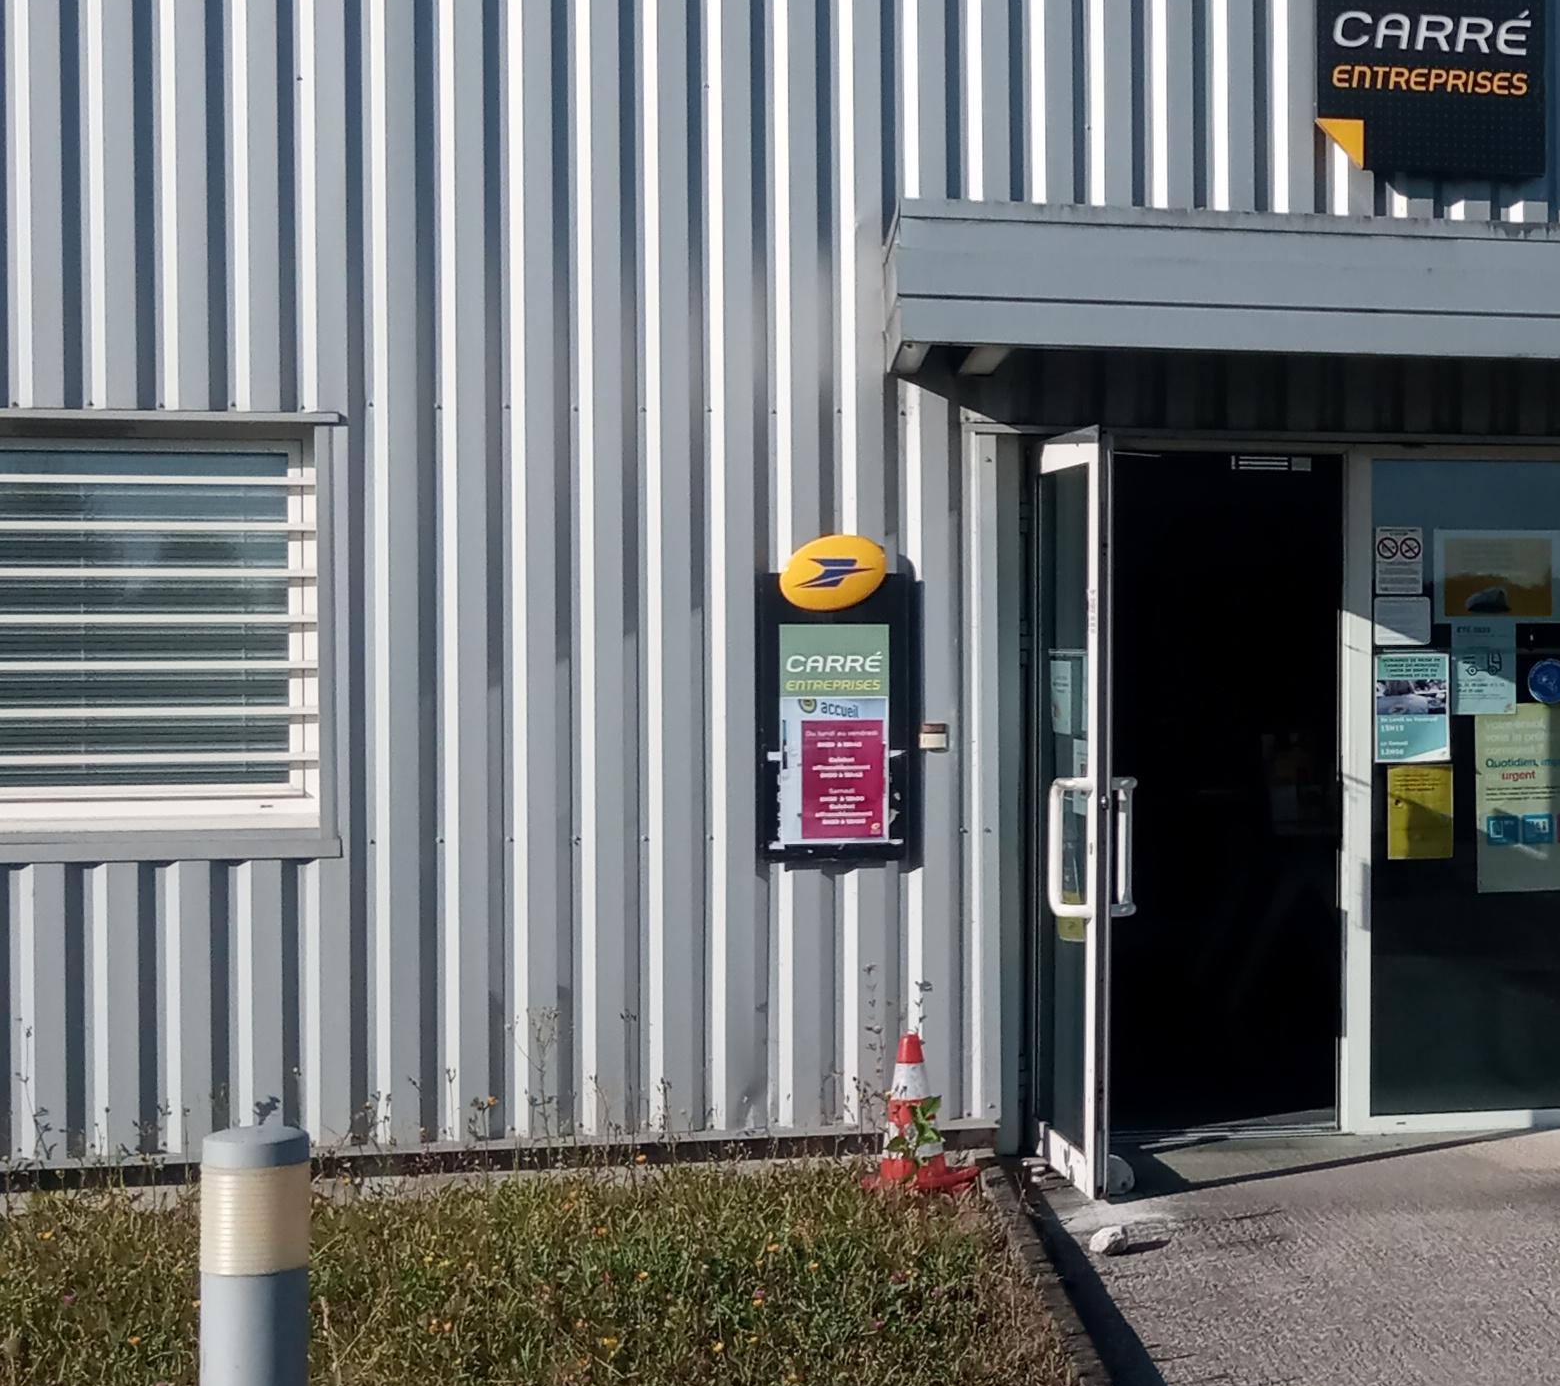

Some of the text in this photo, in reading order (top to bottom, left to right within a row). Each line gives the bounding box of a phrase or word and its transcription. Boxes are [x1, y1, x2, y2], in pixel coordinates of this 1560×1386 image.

[1332, 9, 1532, 56] CARRÉ
[1332, 65, 1529, 95] ENTREPRISES
[785, 651, 884, 673] CARRÉ
[784, 679, 882, 691] ENTREPRISES
[820, 701, 860, 718] accueil
[1485, 758, 1539, 768] Quotidien,
[1501, 770, 1536, 781] urgent
